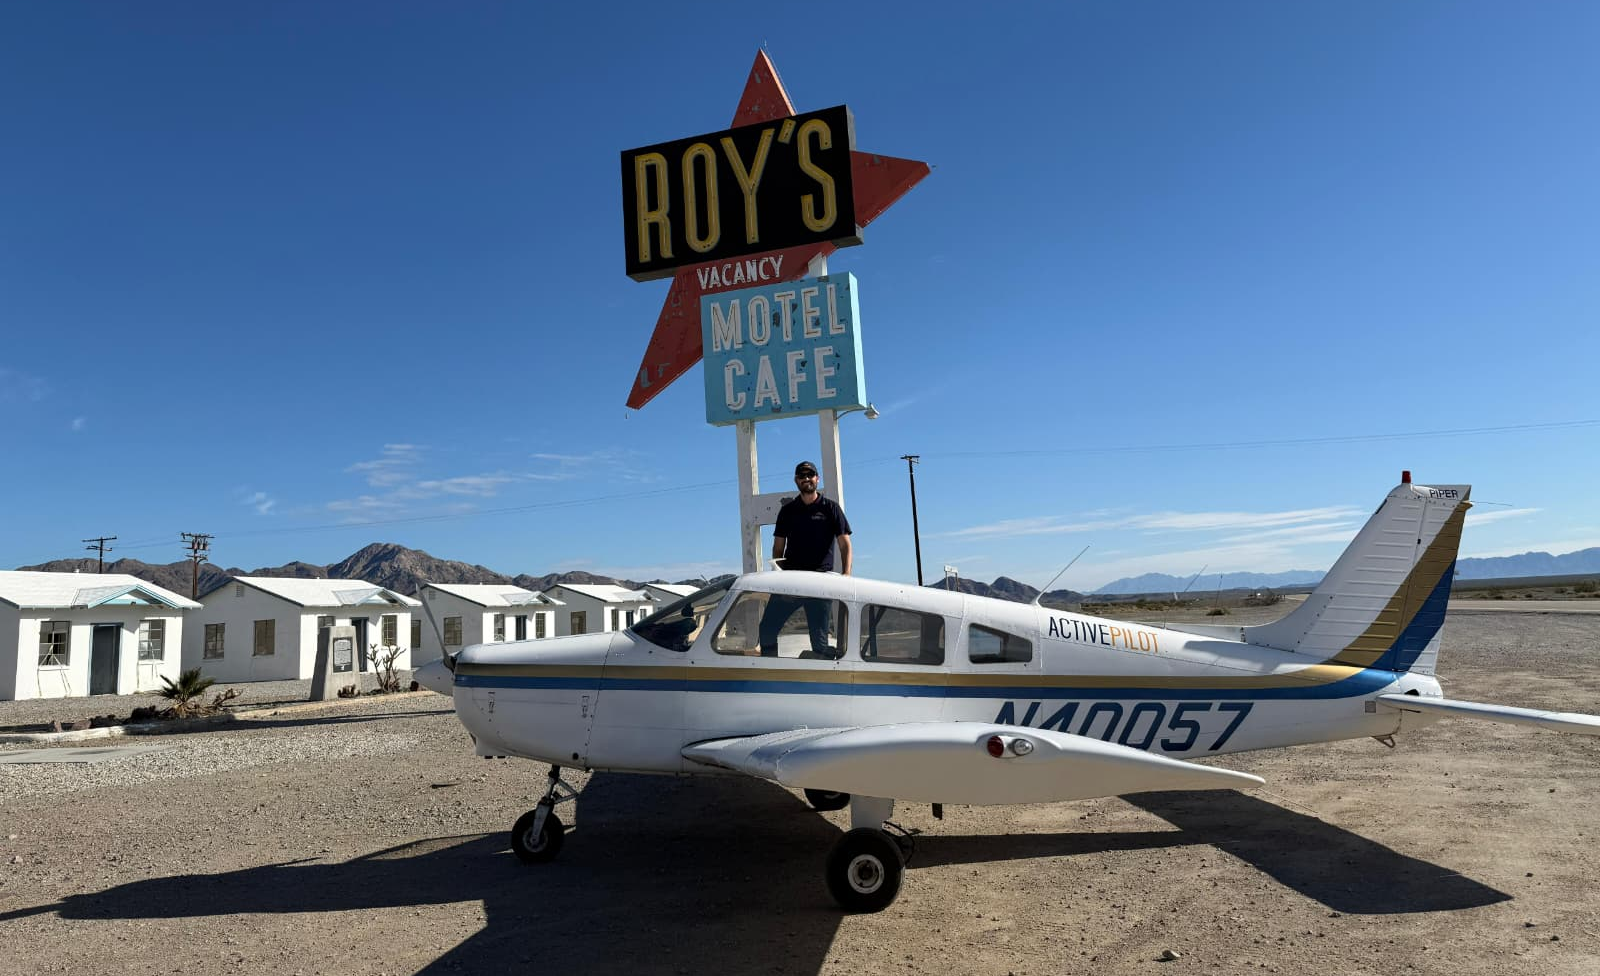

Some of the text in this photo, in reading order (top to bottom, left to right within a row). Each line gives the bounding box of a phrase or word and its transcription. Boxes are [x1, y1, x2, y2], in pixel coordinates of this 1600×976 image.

[635, 118, 837, 264] ROY'S
[697, 255, 784, 290] VACANCY
[711, 283, 846, 352] MOTEL
[724, 346, 837, 410] CAFE
[1429, 489, 1459, 499] PIPER
